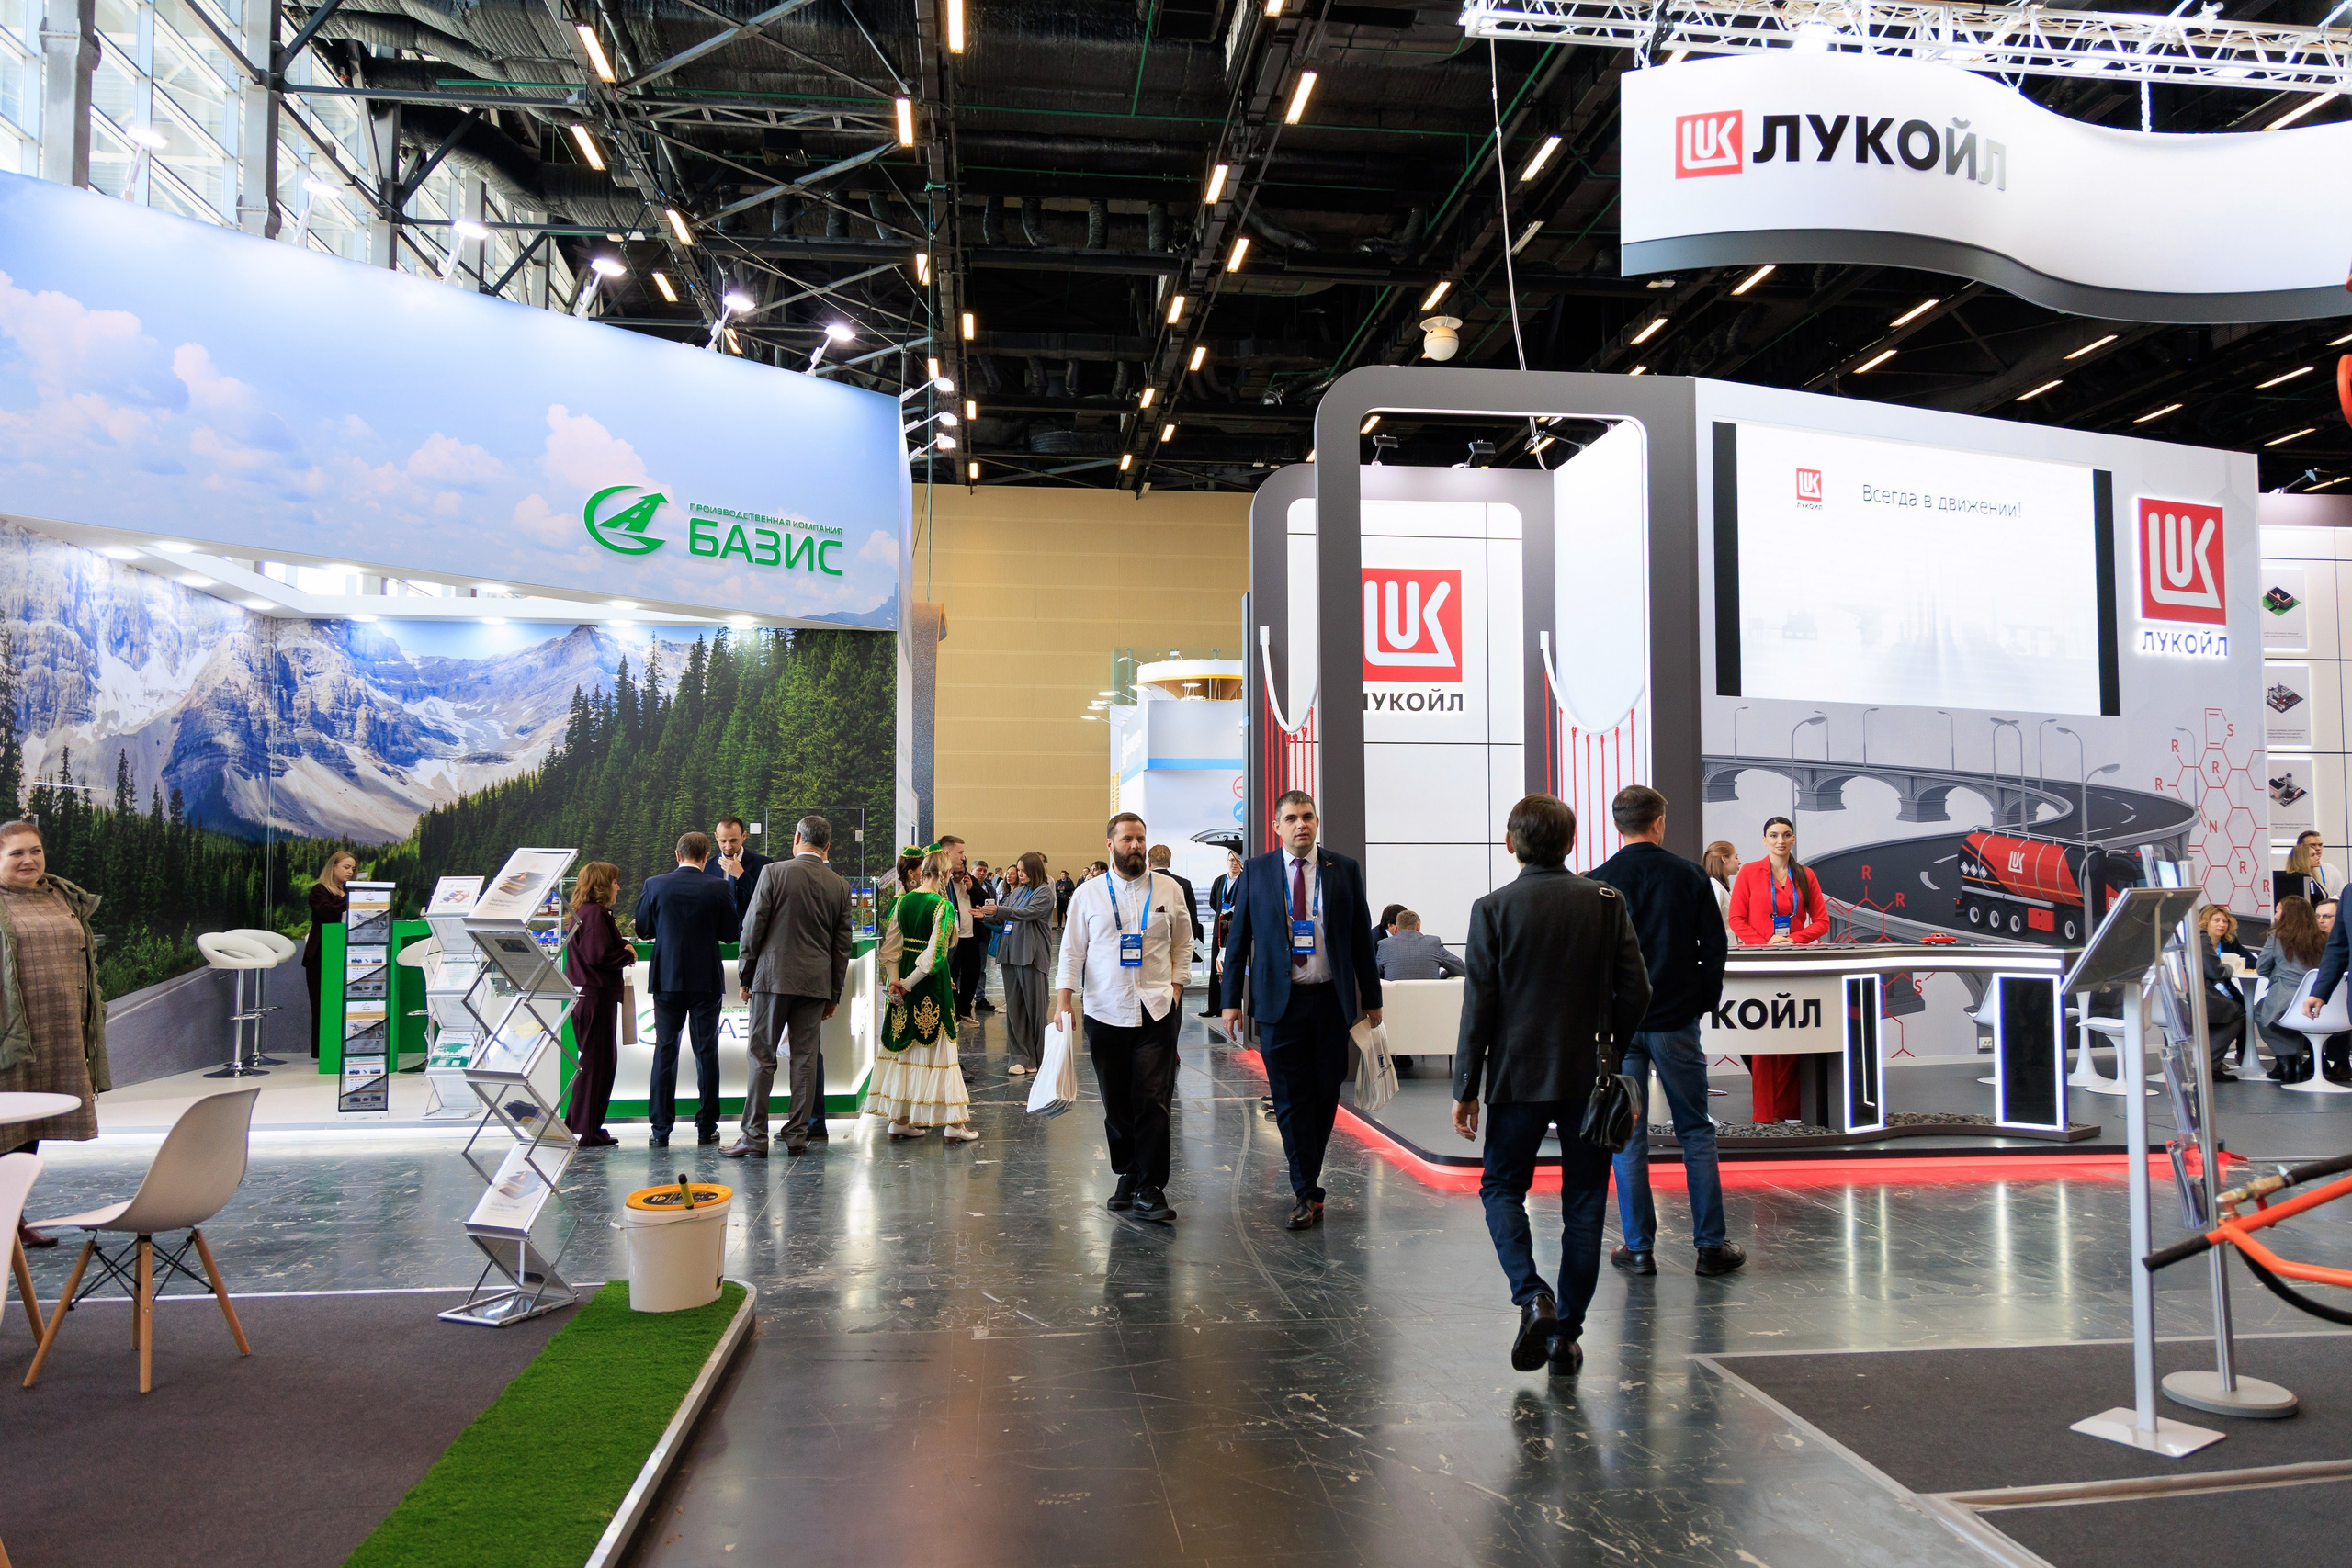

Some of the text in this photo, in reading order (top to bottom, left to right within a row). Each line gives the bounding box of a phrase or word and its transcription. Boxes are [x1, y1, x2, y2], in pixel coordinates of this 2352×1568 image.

[1752, 113, 2007, 191] ЛУКОЙЛ
[1862, 484, 2021, 518] Всегда в движении!
[689, 502, 843, 536] ПРОИЗВОДСТВЕННАЯ КОМПАНИЯ
[688, 517, 843, 577] БАЗИС
[2142, 630, 2228, 656] ЛУКОЙЛ
[2226, 723, 2234, 737] S
[2171, 739, 2180, 752] R
[2211, 761, 2221, 774] R
[2155, 777, 2164, 791] R
[2209, 820, 2218, 834] N
[1861, 864, 1872, 881] R
[2239, 861, 2247, 874] R
[2263, 879, 2270, 893] R
[1895, 892, 1905, 908] R
[1914, 978, 1923, 995] S
[1711, 992, 1822, 1030] КОЙЛ
